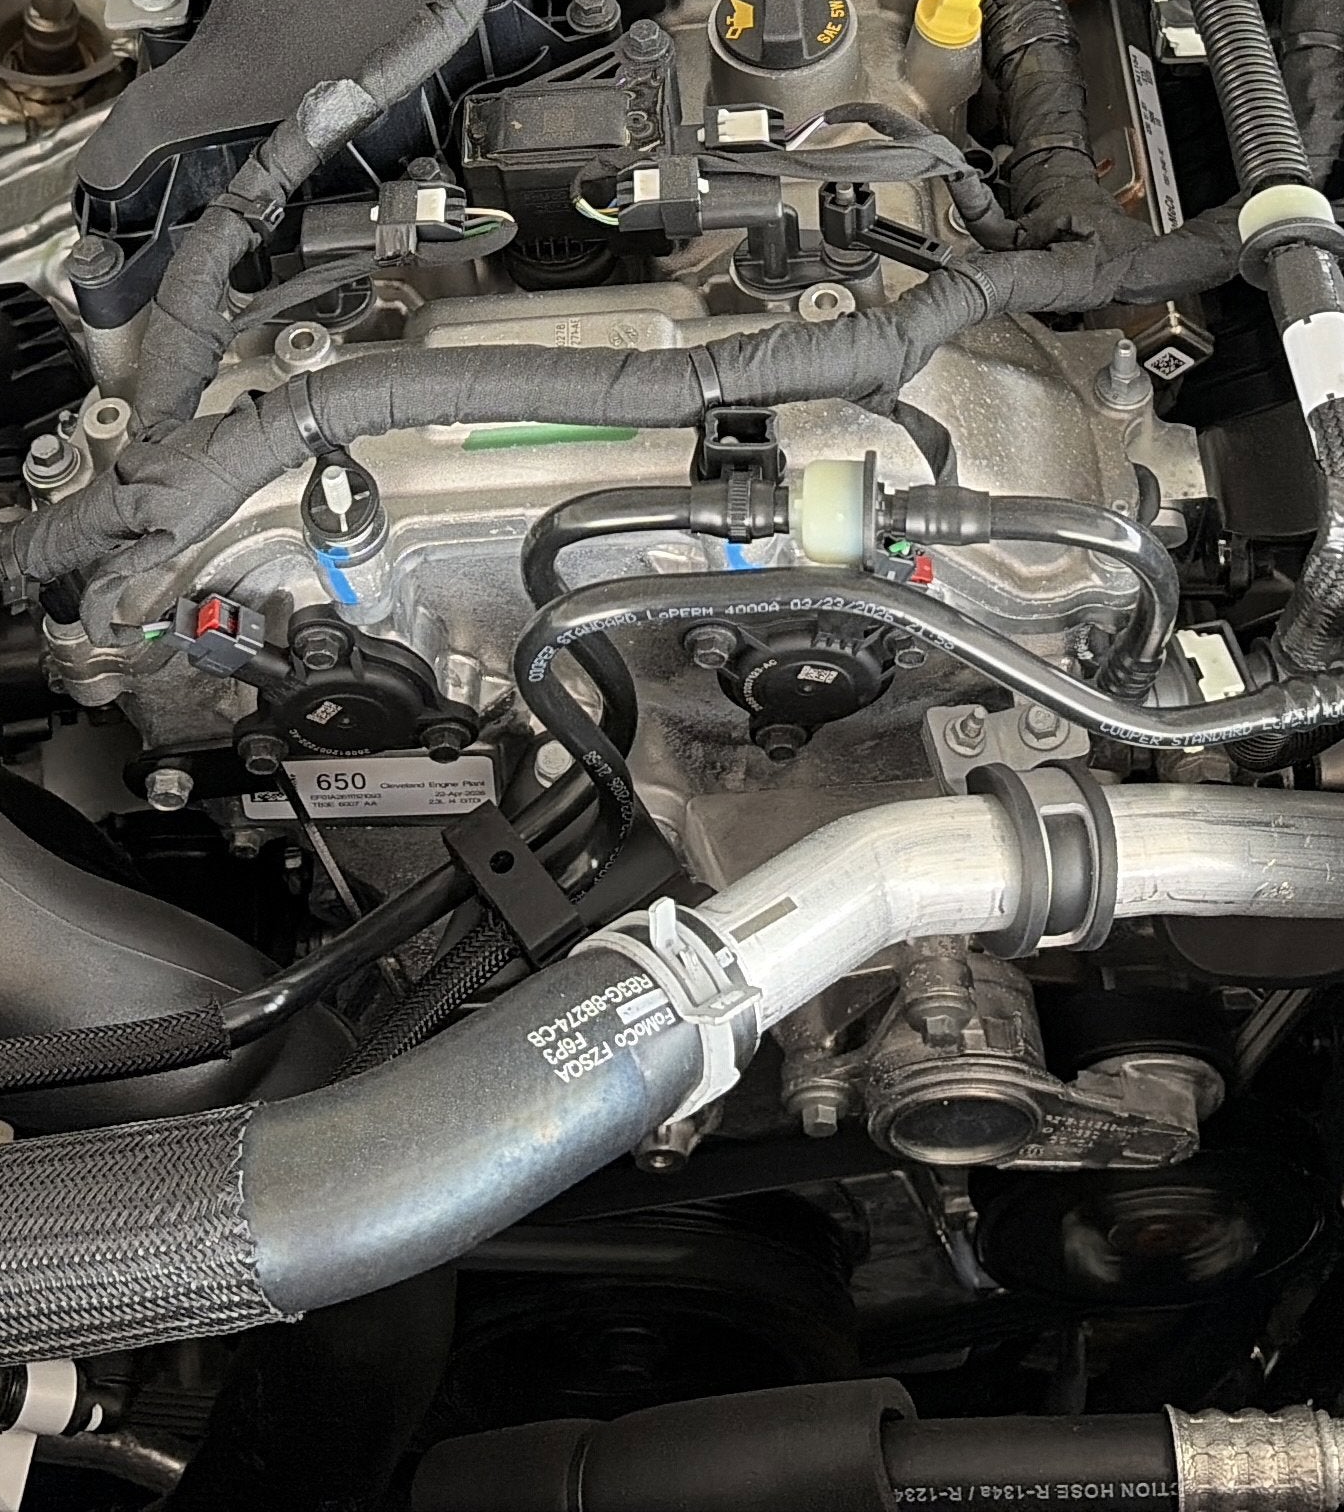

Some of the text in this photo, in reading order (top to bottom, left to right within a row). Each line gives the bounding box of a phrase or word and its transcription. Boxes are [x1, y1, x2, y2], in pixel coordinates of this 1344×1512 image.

[816, 19, 846, 45] SAE
[555, 611, 638, 646] STANDARD
[1170, 719, 1251, 746] STANDARD
[316, 771, 486, 791] 650 Cleveland Engine Plant
[524, 969, 653, 1048] RB3G-8B274-CB
[541, 1030, 587, 1066] F6P3
[553, 1005, 676, 1085] FoMoCo FZSQA
[979, 1483, 1049, 1499] R-134a
[1055, 1482, 1113, 1499] HOSE
